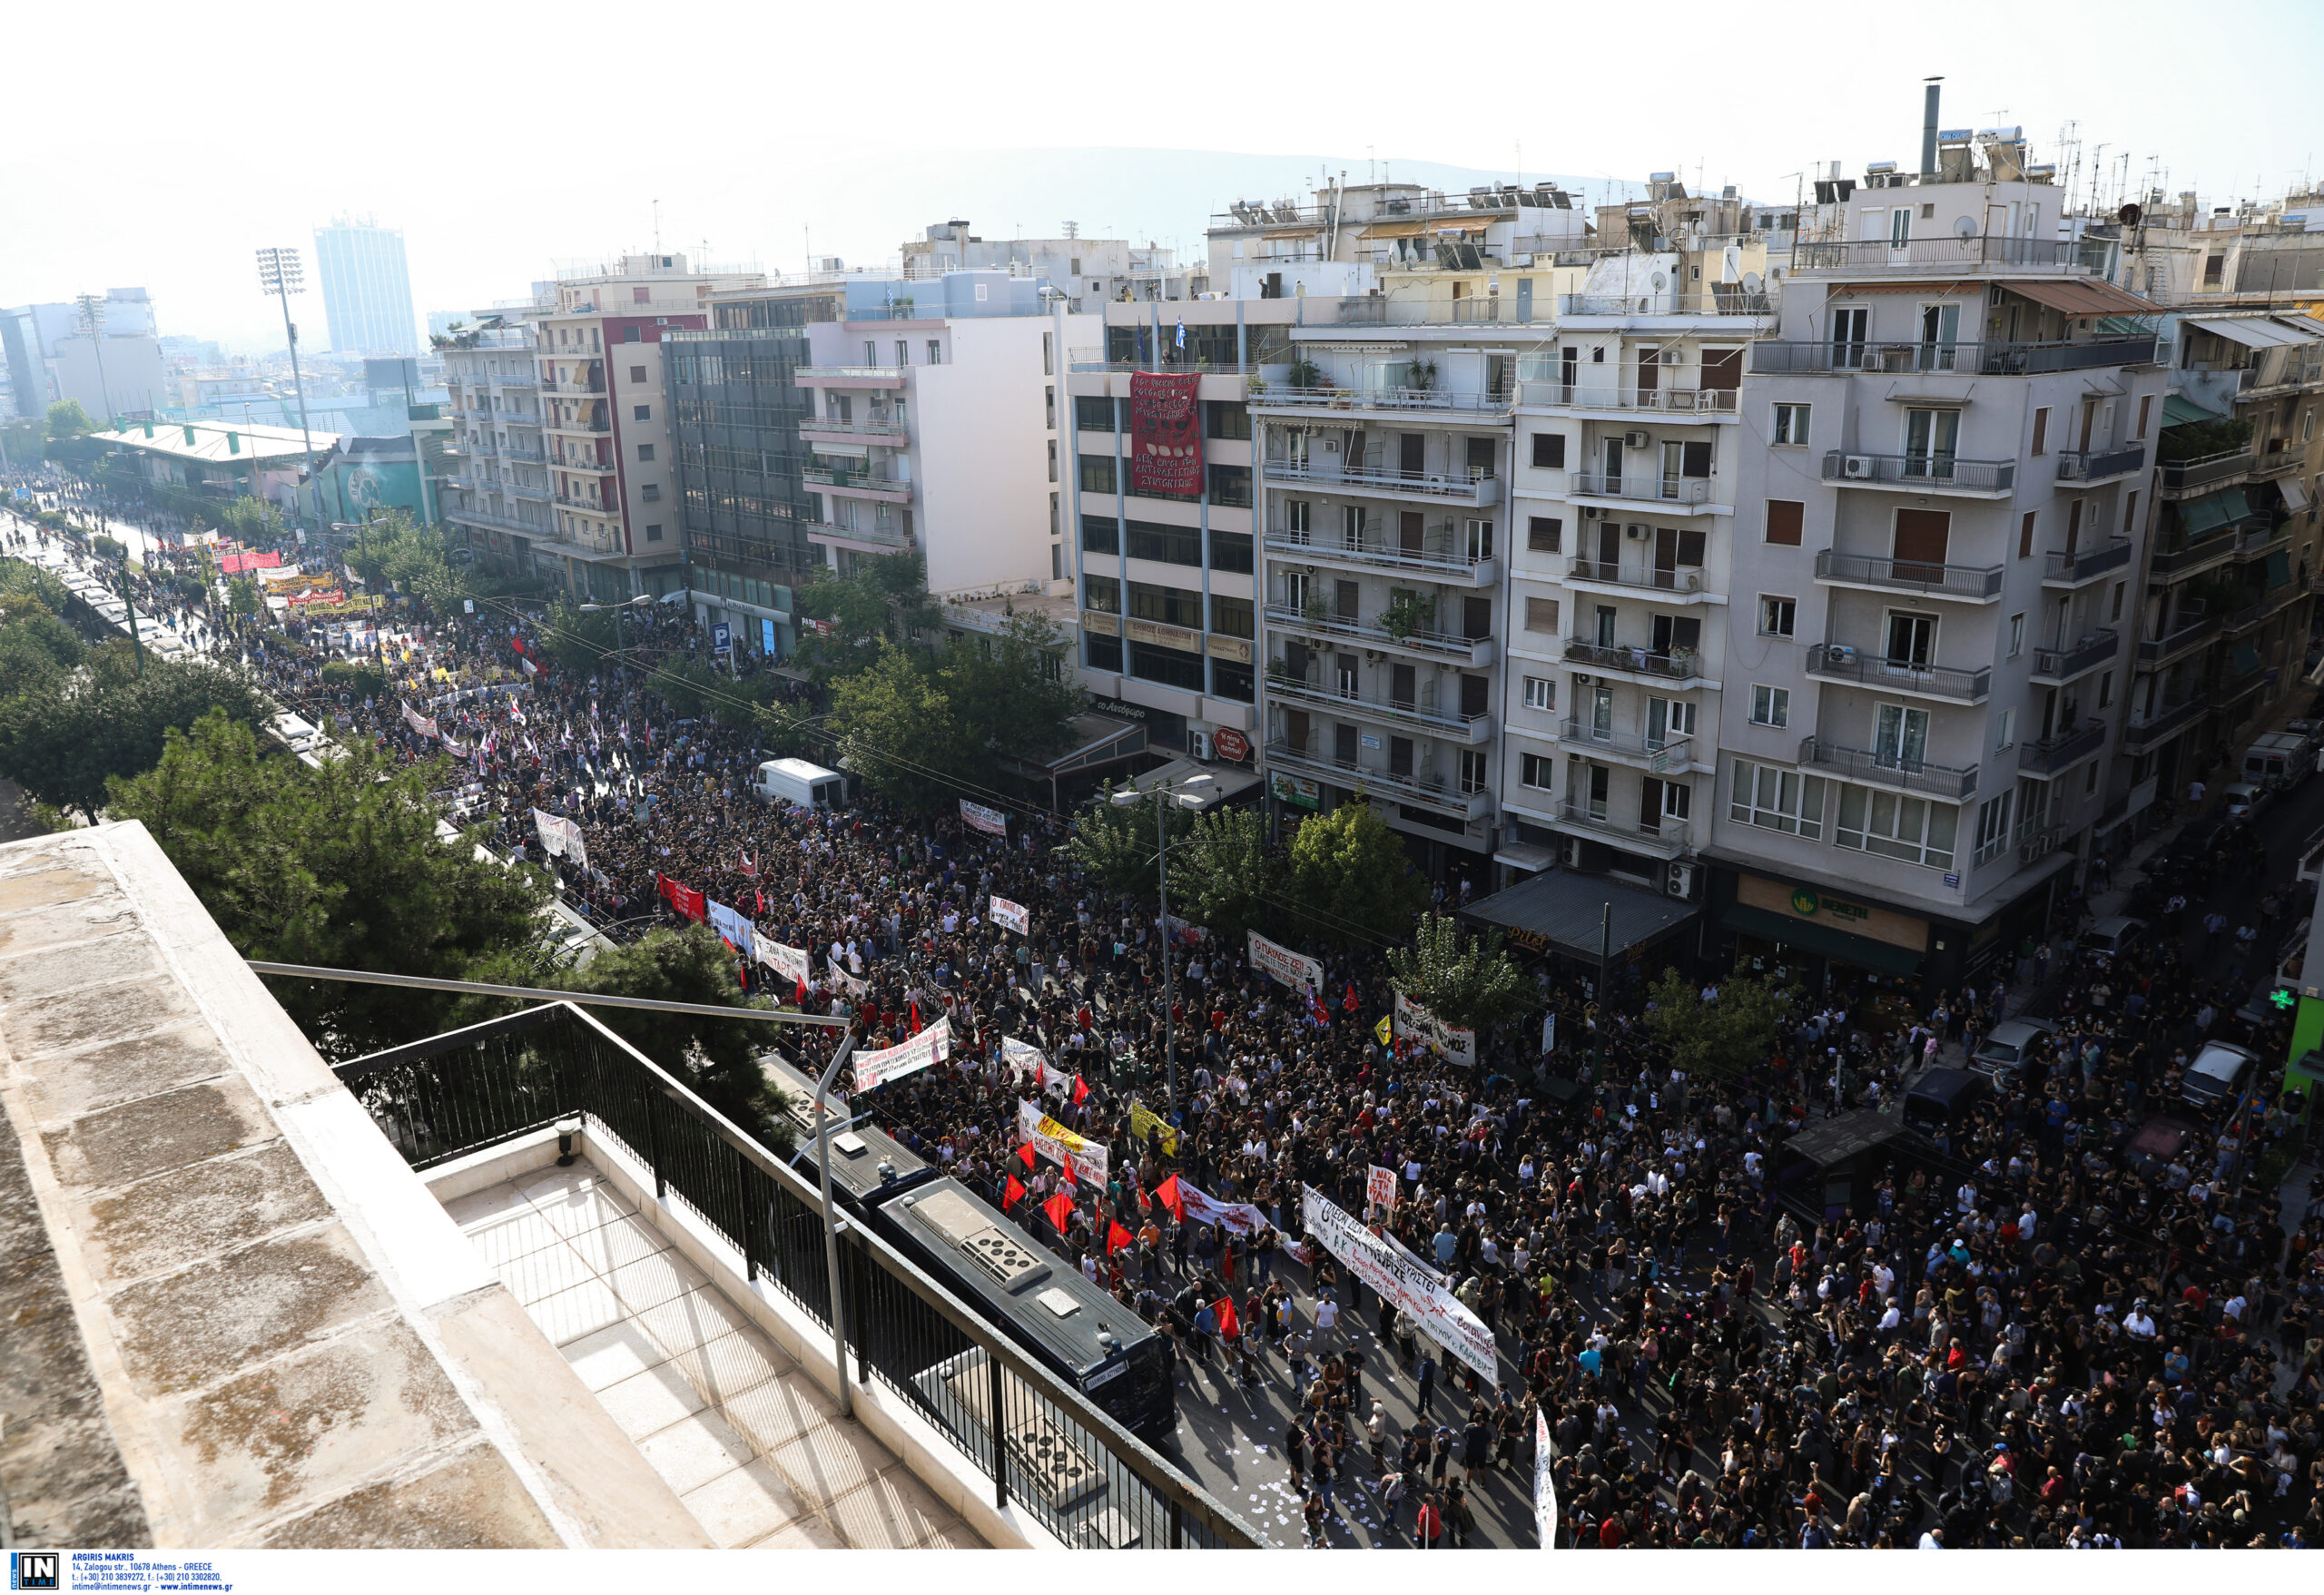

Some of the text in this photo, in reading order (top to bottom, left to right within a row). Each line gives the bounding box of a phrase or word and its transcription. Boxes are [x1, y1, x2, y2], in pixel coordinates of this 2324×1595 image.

[727, 602, 756, 614] ALPHA BANK
[714, 628, 726, 645] P
[1132, 623, 1156, 634] ΔΗΜΟΣ
[1157, 628, 1192, 640] ΑΘΗΝΑΙΩΝ
[1098, 701, 1145, 719] το Αυτόφωρο
[1507, 925, 1547, 950] Pilot
[1255, 940, 1261, 950] Ο
[1262, 943, 1289, 965] ΠΑΥΛΟΣ
[1372, 1178, 1389, 1192] ΣΤΗ
[1376, 1170, 1394, 1184] ΝΑΖΙ
[1369, 1185, 1395, 1210] ΦΥΛΑΚ
[1324, 1201, 1349, 1225] ΠΛΕΟΝ
[1348, 1221, 1363, 1236] ΔΕΝ
[1364, 1231, 1384, 1253] ΜΠΟΡΕΙ
